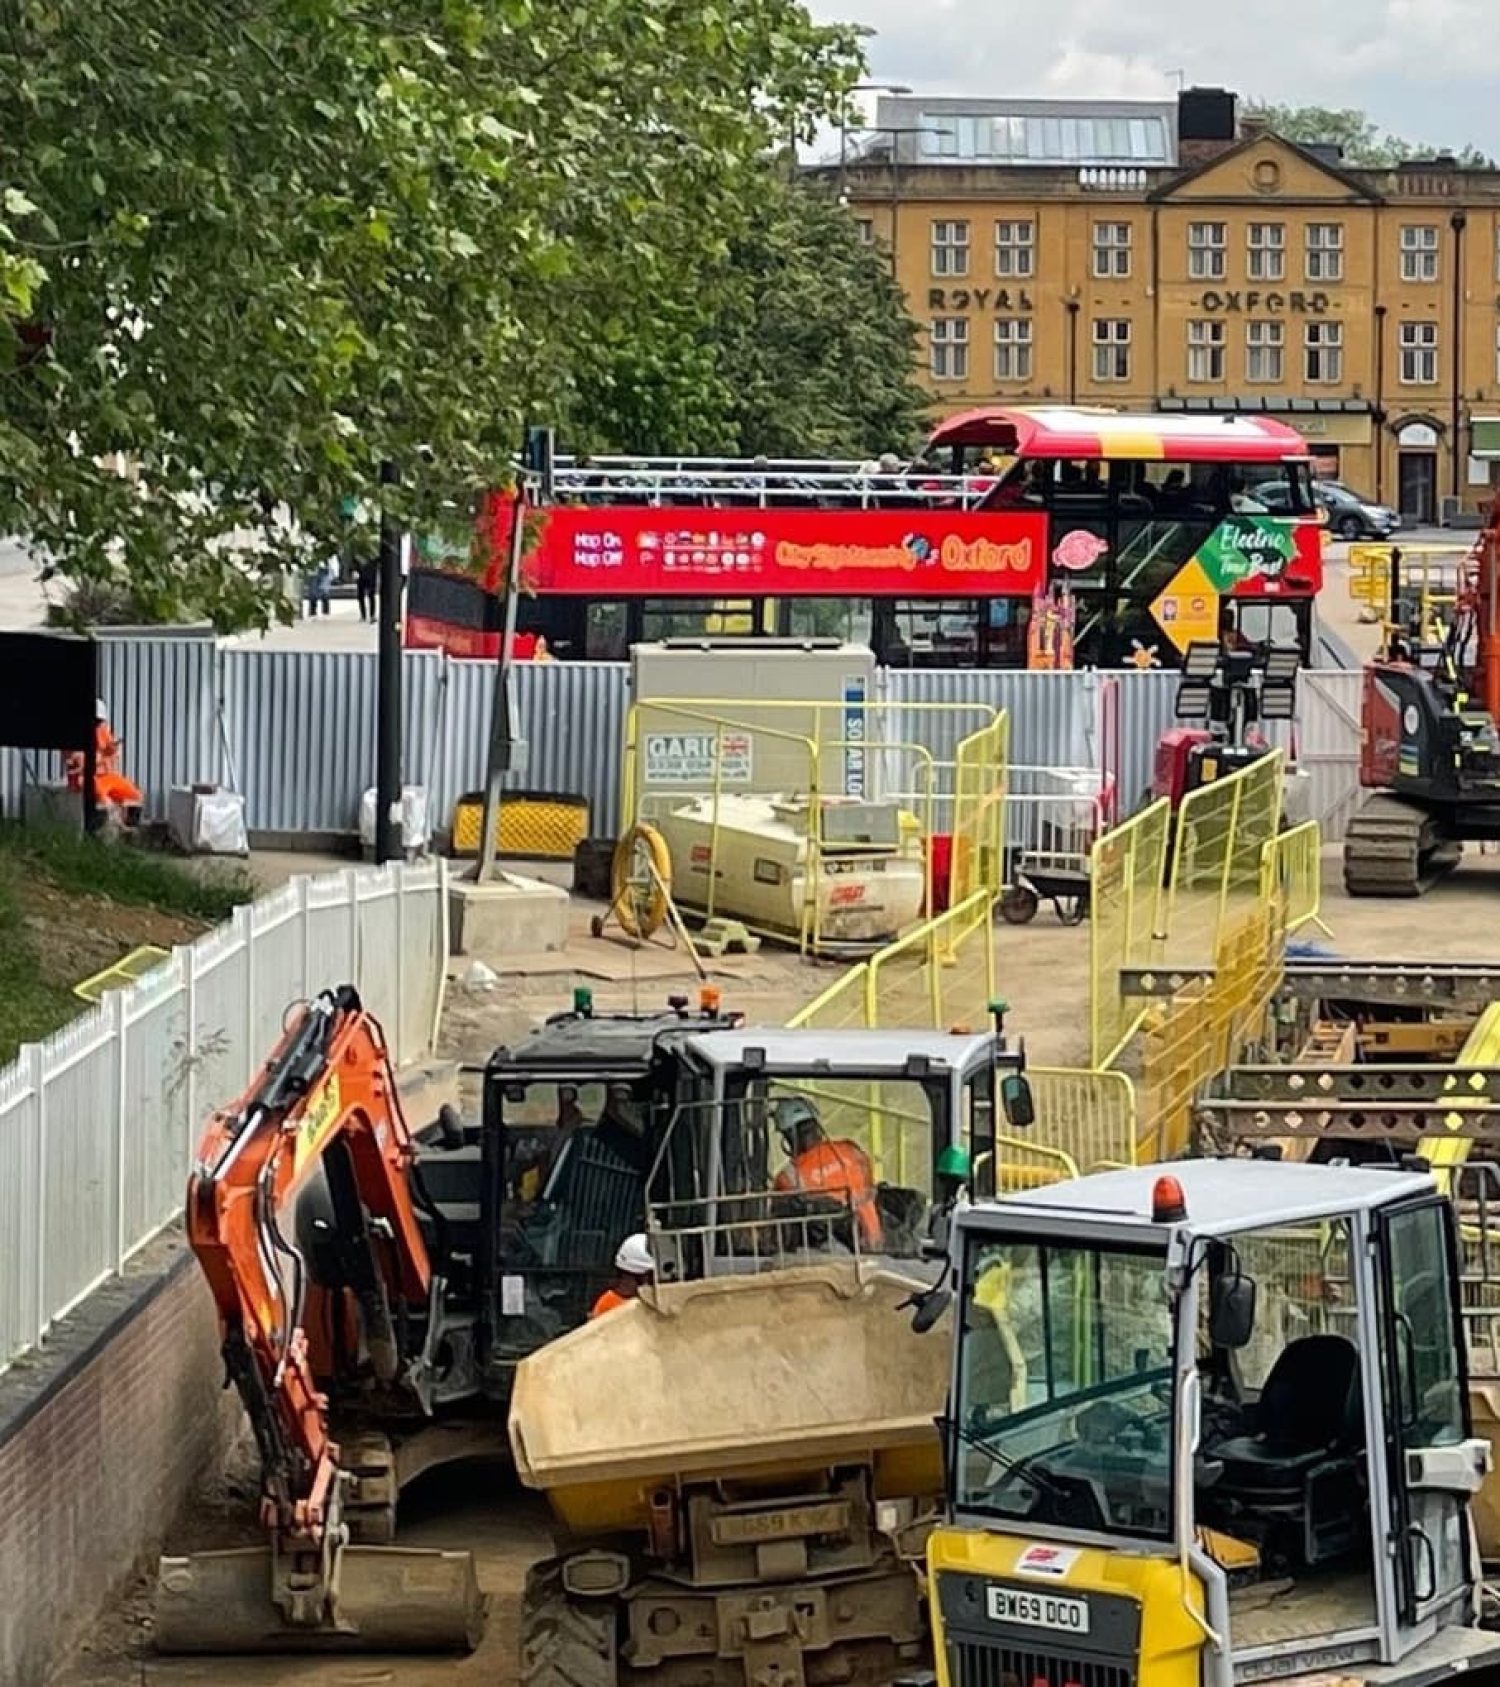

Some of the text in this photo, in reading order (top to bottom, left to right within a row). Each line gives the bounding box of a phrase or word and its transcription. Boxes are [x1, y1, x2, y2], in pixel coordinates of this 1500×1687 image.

[929, 289, 1033, 311] ROYAL
[1202, 290, 1330, 314] OXFORD
[941, 534, 1032, 572] Oxford
[1221, 524, 1285, 550] Electric
[847, 717, 863, 770] SOAR
